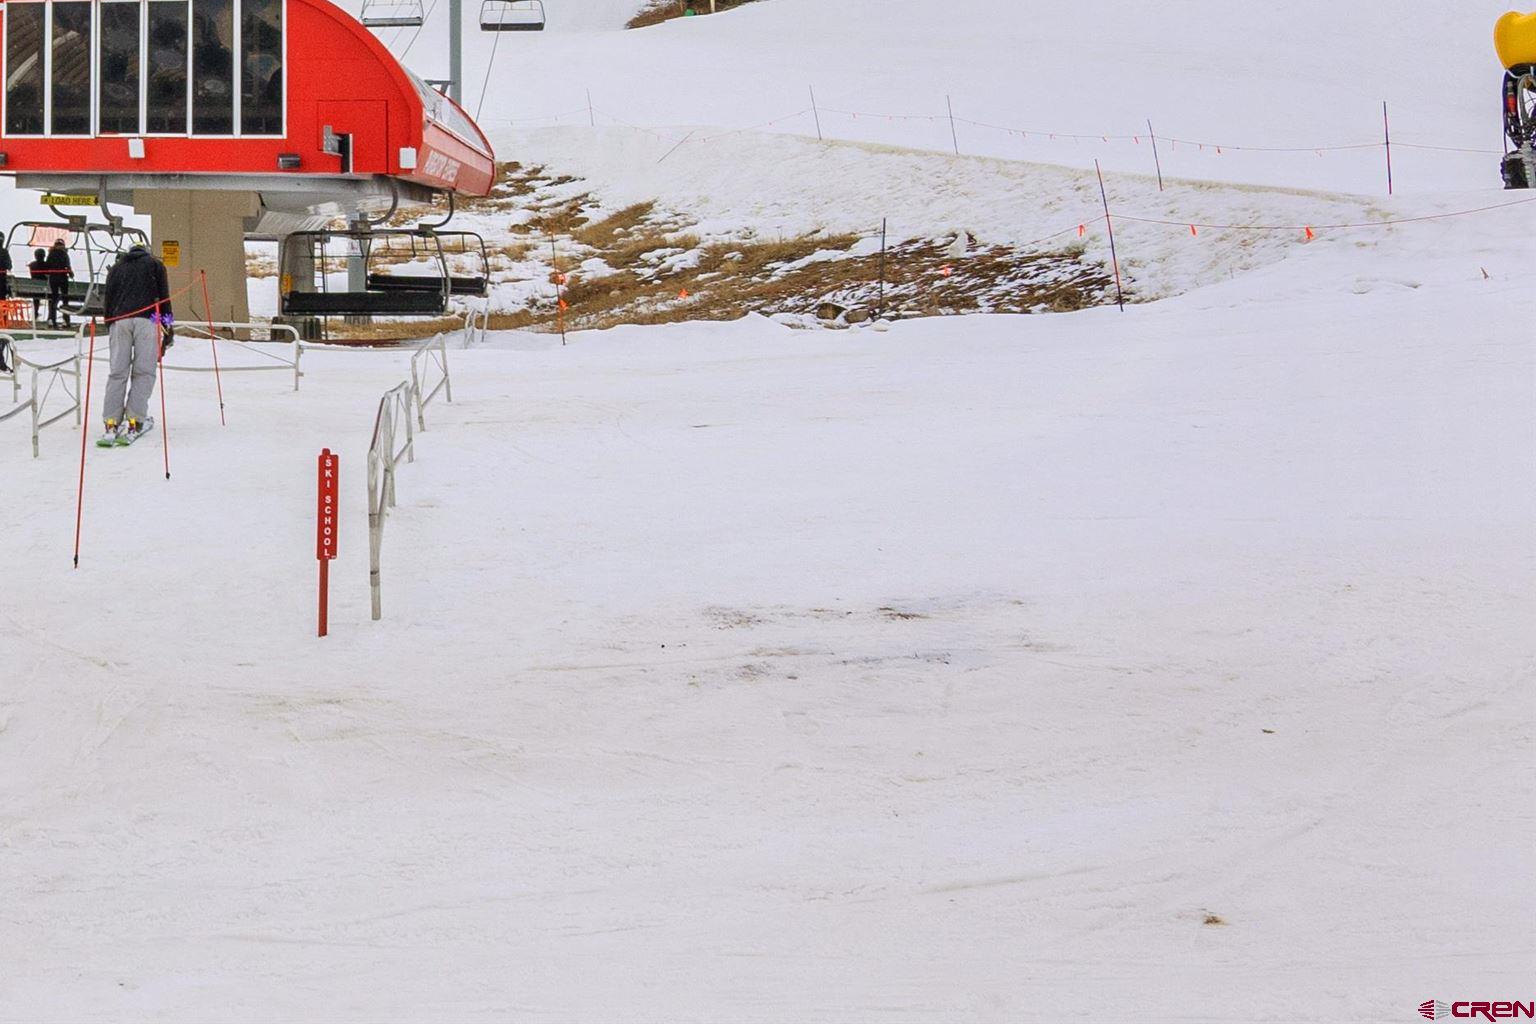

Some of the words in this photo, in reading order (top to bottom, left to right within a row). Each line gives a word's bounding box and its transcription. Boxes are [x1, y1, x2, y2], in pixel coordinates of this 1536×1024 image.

[51, 196, 71, 205] LOAD
[72, 196, 92, 205] HERE
[323, 495, 331, 556] SCHOOL
